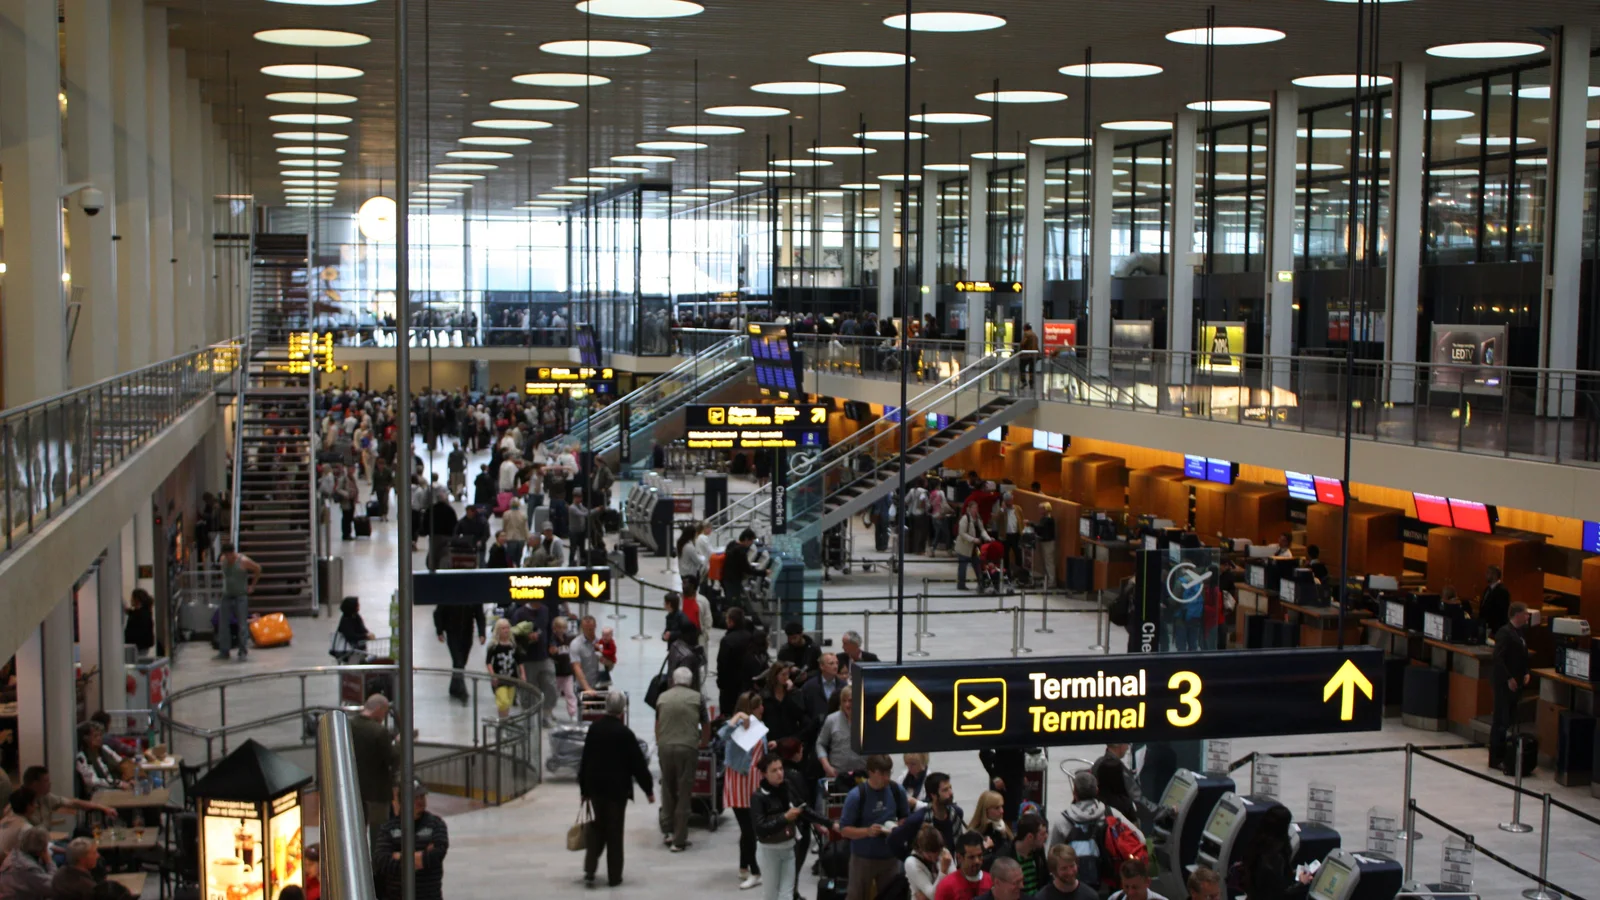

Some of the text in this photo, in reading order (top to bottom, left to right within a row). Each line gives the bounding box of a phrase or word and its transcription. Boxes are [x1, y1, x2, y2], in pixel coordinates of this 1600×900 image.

[775, 485, 785, 525] Check-in
[509, 575, 553, 587] Toiletter
[509, 587, 545, 599] Toilets
[1029, 669, 1146, 700] Terminal
[1166, 670, 1202, 727] 3
[1029, 702, 1146, 733] Terminal
